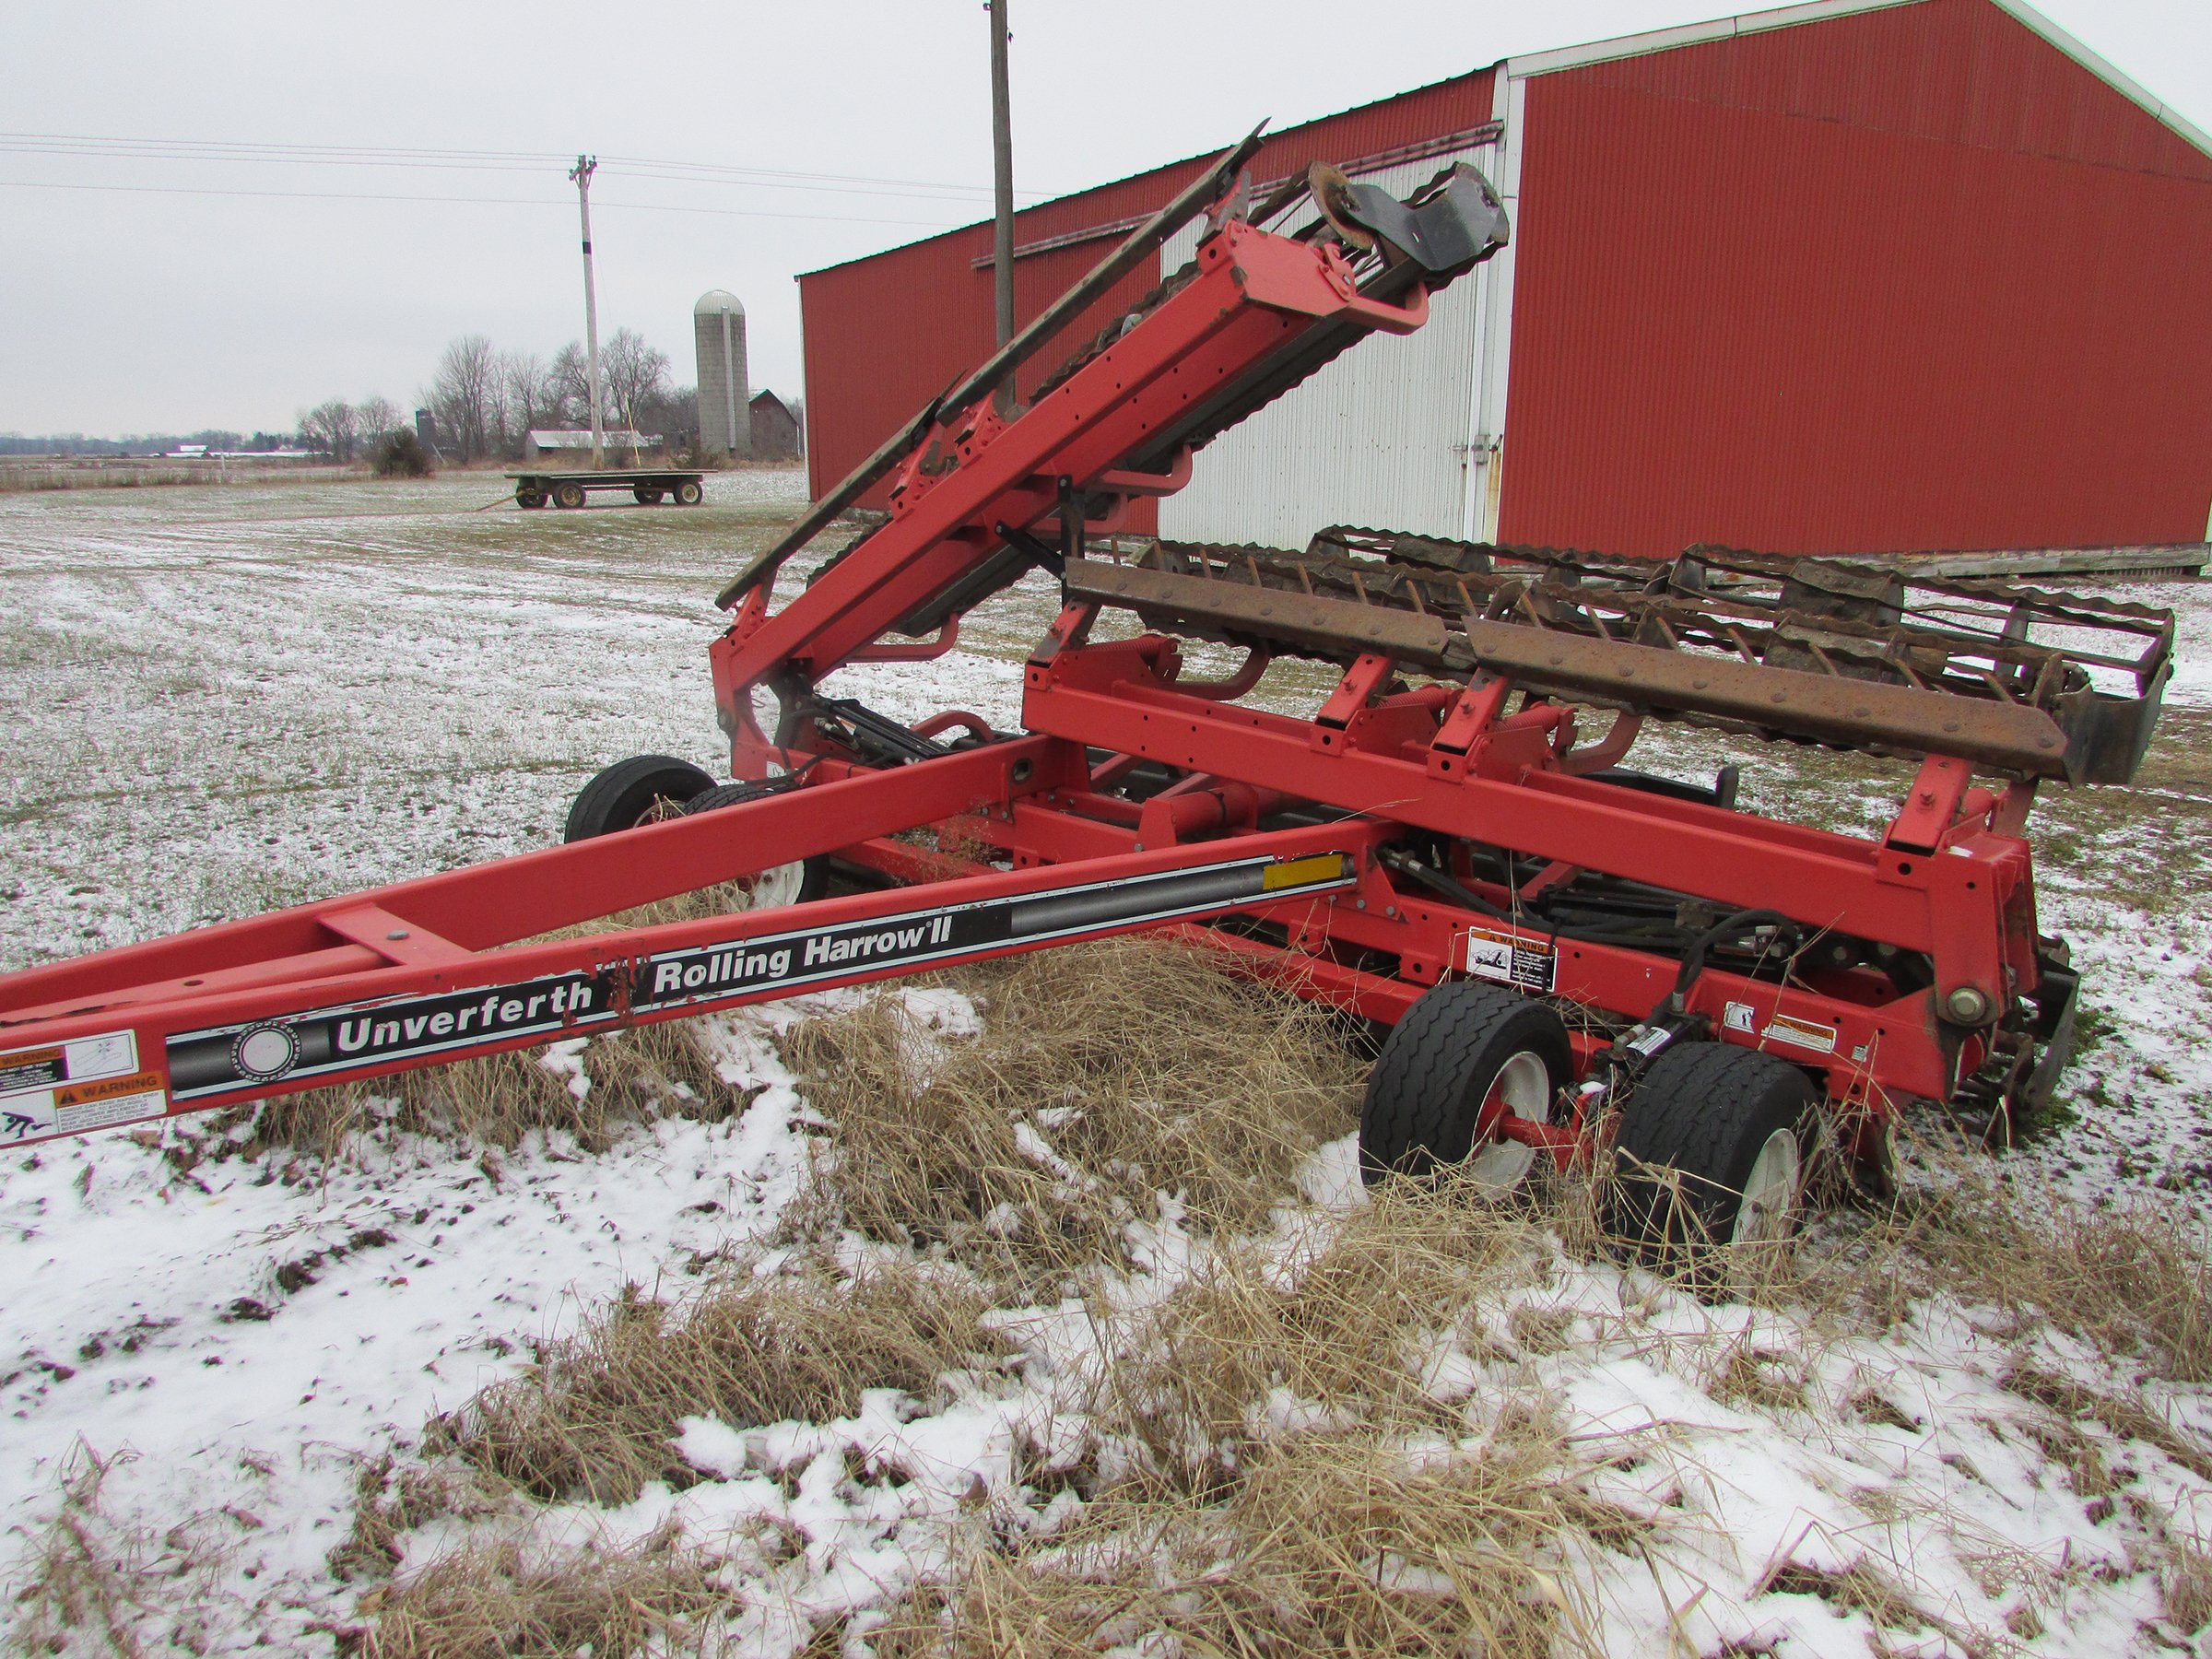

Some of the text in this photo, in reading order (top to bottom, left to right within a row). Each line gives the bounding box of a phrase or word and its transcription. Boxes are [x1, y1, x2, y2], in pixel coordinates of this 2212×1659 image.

[1500, 935, 1544, 952] WARNING
[337, 915, 953, 1052] Unverferth Rolling Harrow II
[1790, 1022, 1828, 1036] WARNING
[2, 1049, 60, 1065] WARNING
[82, 1076, 157, 1097] WARNING
